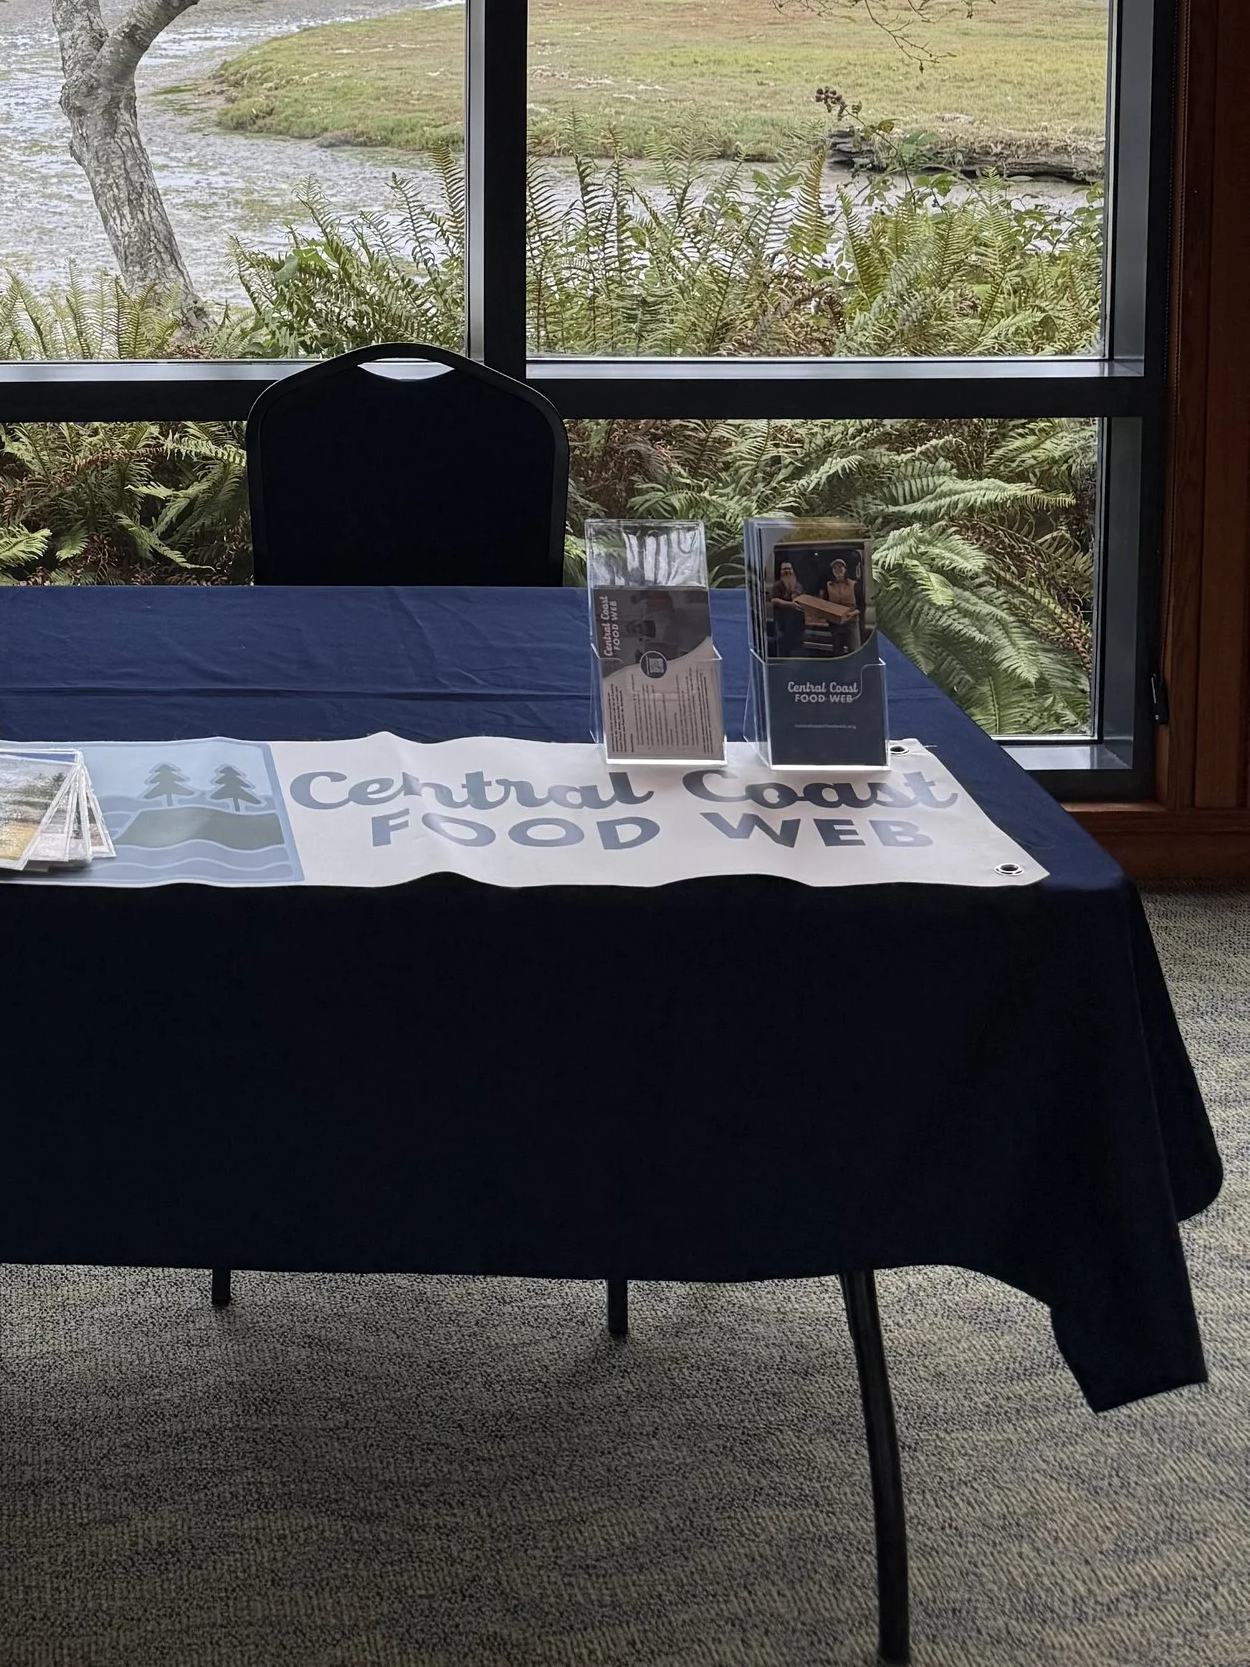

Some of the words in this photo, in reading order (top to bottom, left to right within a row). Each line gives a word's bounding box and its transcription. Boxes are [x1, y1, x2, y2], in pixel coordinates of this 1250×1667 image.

[600, 595, 609, 621] Coast
[601, 622, 613, 656] Central
[612, 624, 621, 651] FOOD
[788, 681, 827, 693] Central
[830, 682, 859, 693] Coast
[795, 694, 826, 702] FOOD
[830, 694, 853, 703] WEB
[290, 771, 654, 810] Central
[682, 769, 958, 809] Coast
[371, 808, 661, 850] FOOD
[700, 812, 934, 848] WEB
